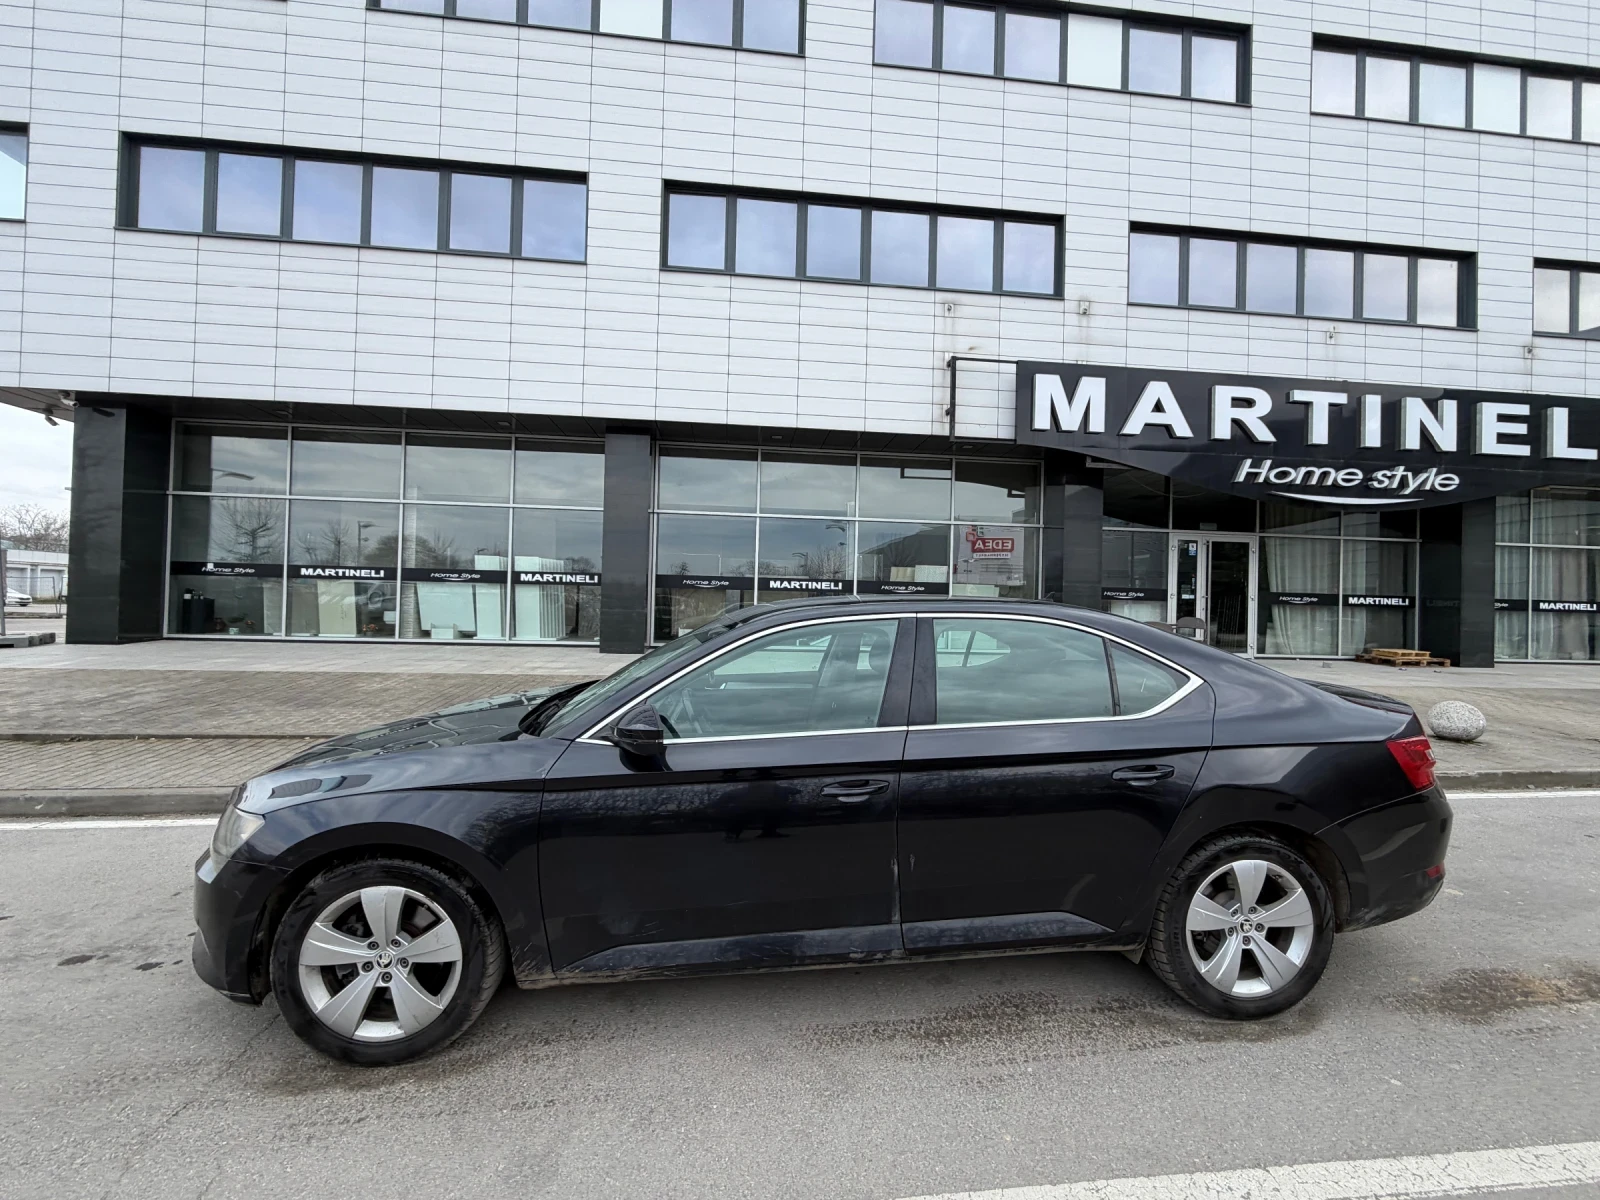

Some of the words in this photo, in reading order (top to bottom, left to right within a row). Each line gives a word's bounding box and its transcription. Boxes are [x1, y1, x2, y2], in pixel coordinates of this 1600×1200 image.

[1031, 373, 1598, 460] MARTINEL
[1233, 458, 1363, 487] Home
[300, 567, 385, 578] MARTINELI
[520, 573, 598, 583] MARTINELI
[769, 580, 842, 590] MARTINELI
[1348, 596, 1409, 606] MARTINELI
[1539, 602, 1597, 611] MARTINELI
